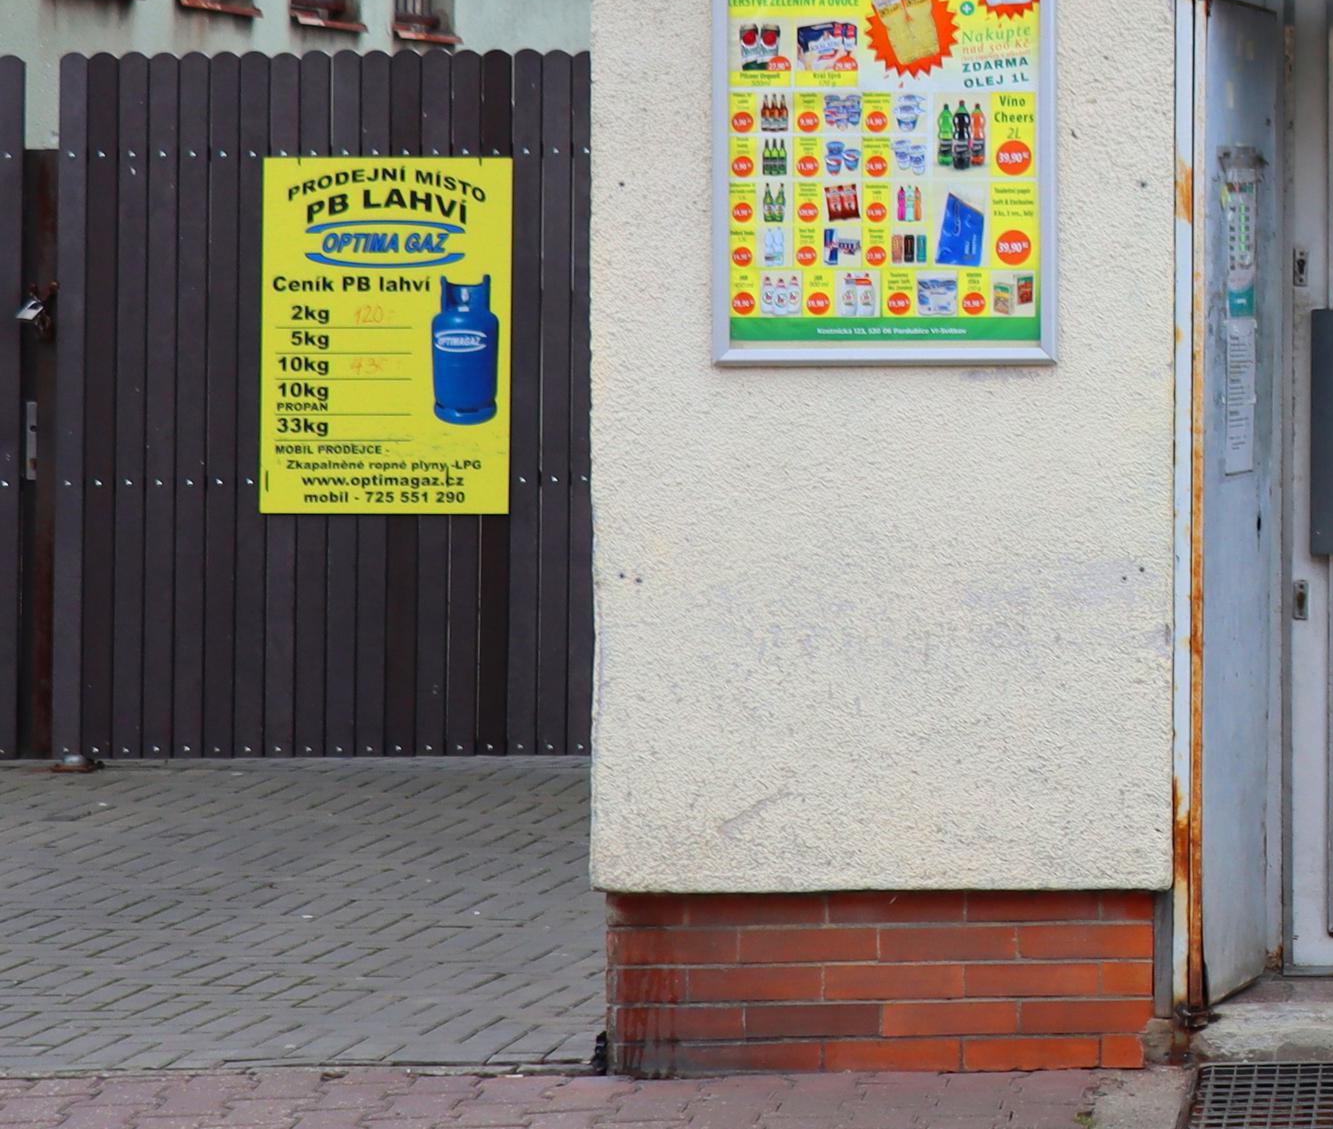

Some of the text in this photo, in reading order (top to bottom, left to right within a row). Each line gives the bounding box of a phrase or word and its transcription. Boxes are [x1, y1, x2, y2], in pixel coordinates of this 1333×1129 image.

[961, 26, 1031, 44] Nakupte
[962, 56, 1029, 73] ZDARMA
[963, 72, 1030, 88] OLEJ 1L
[999, 95, 1026, 107] Víno
[994, 112, 1034, 123] Cheers
[1007, 127, 1022, 139] 2L
[288, 166, 486, 203] PRODEJNÍ MÍSTO
[307, 188, 467, 224] PB LAHVÍ
[322, 232, 449, 253] OPTIMA GAZ
[272, 276, 431, 292] Ceník PB lahví
[291, 305, 330, 324] 2kg
[291, 331, 330, 349] 5kg
[277, 357, 330, 375] 10kg
[277, 383, 329, 401] 10kg
[276, 402, 329, 412] PROPAN
[276, 418, 329, 436] 33kg
[275, 445, 383, 454] MOBIL PRODEJCE
[368, 460, 407, 471] ropné
[411, 460, 447, 471] plyny
[302, 474, 465, 488] www.optimagaz.cz
[304, 491, 466, 503] mobil 725 551 290
